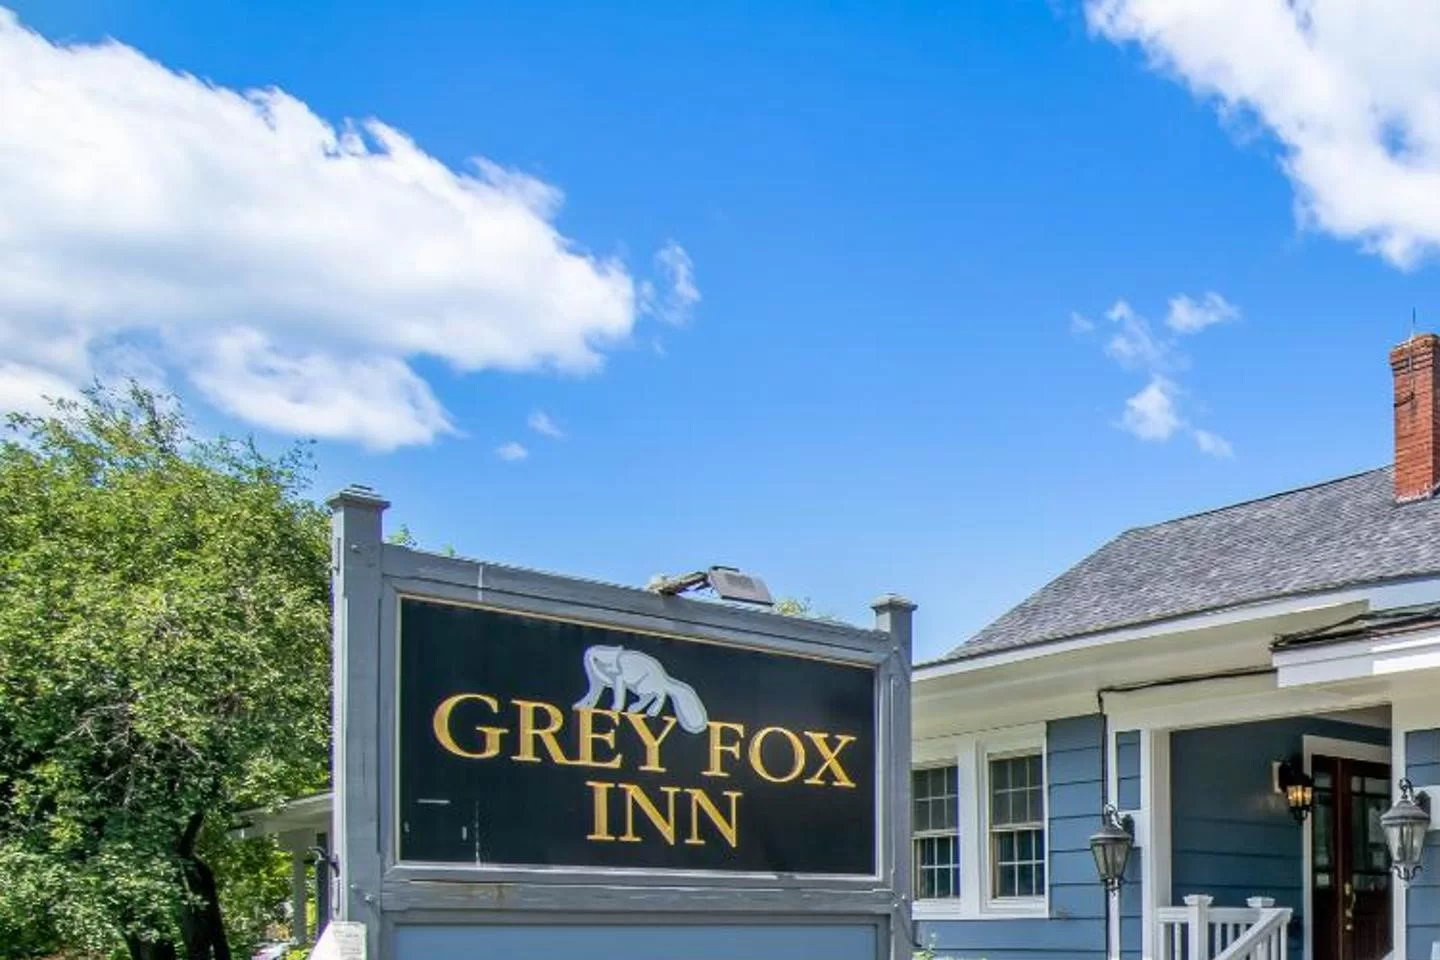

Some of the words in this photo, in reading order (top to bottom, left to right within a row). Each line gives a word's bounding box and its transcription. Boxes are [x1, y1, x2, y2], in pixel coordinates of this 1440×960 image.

[432, 693, 677, 773] GREY
[702, 721, 857, 788] FOX
[586, 780, 742, 848] INN
